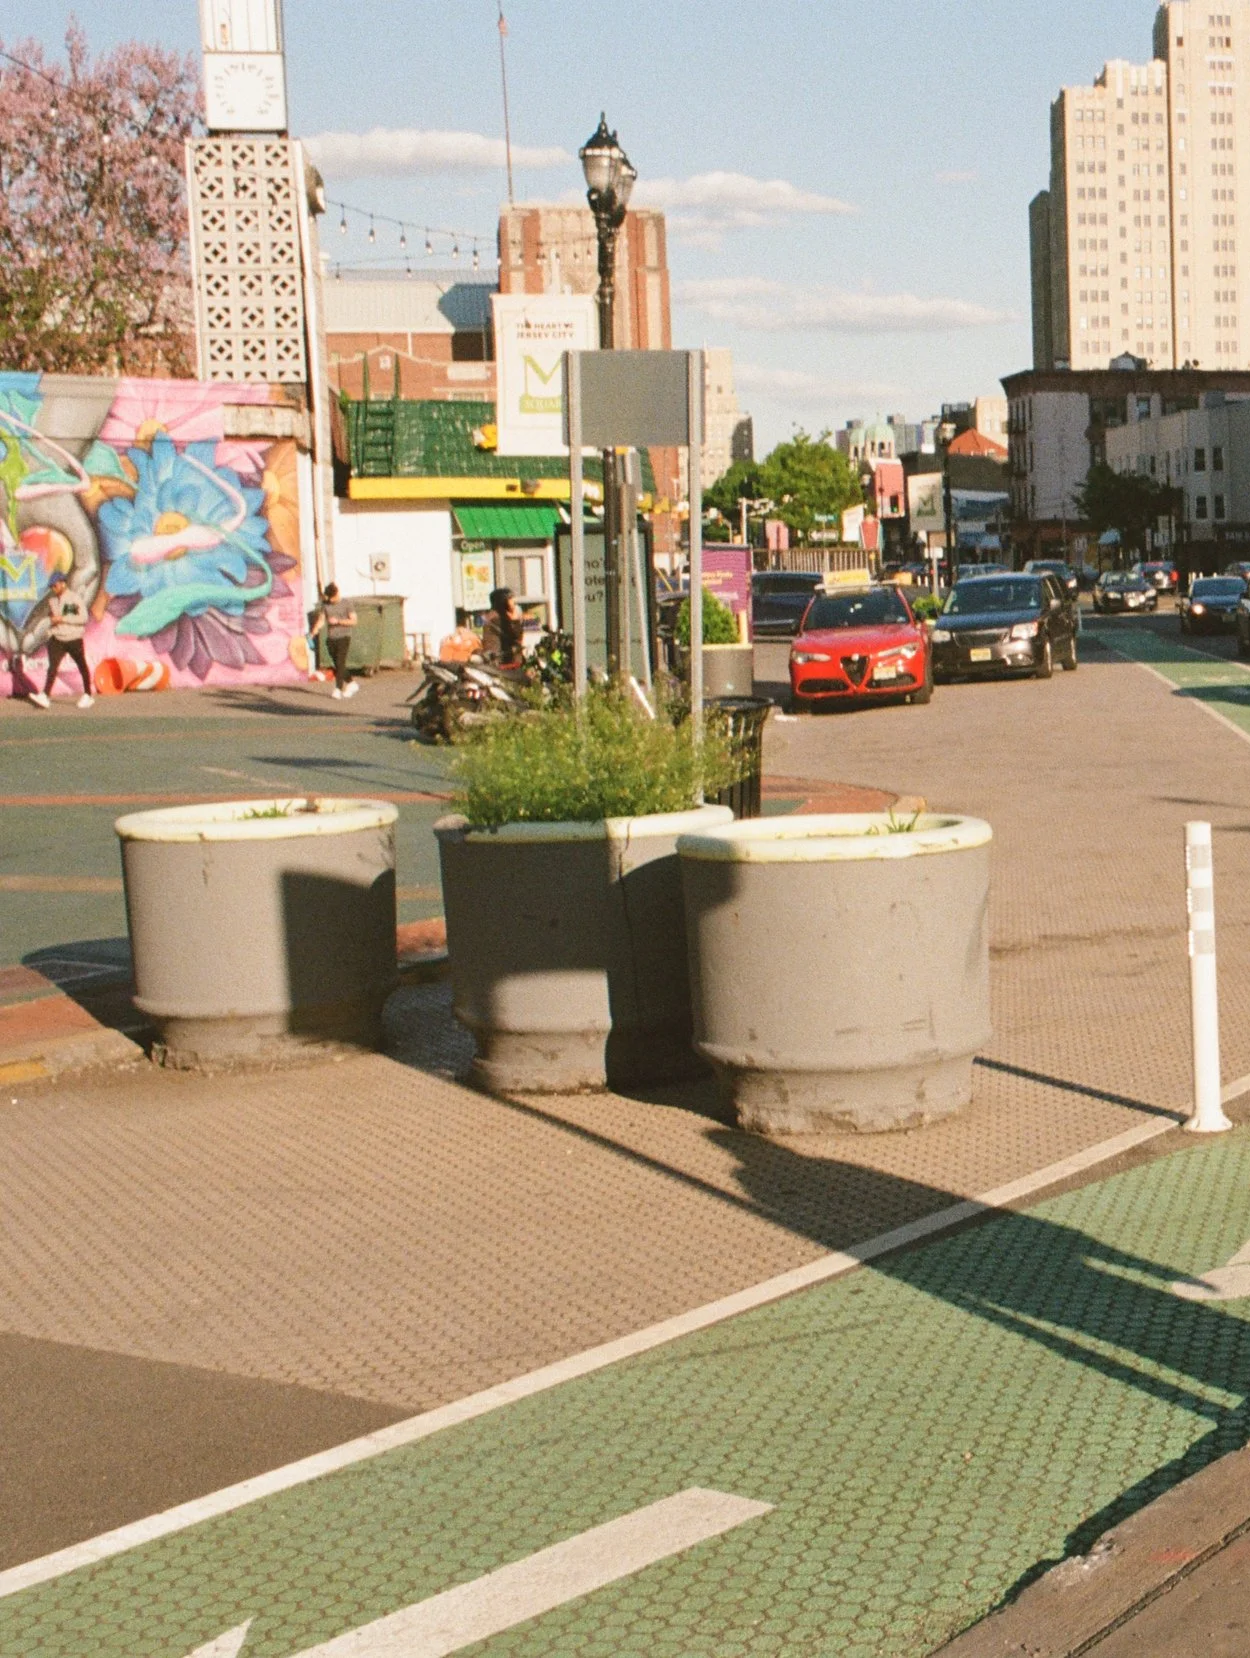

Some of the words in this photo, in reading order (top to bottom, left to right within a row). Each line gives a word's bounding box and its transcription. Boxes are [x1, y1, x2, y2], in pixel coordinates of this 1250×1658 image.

[534, 322, 561, 330] HEART
[517, 331, 549, 339] JERSEY
[552, 331, 574, 339] CITY
[523, 399, 562, 411] SQUAR
[460, 539, 486, 553] Open
